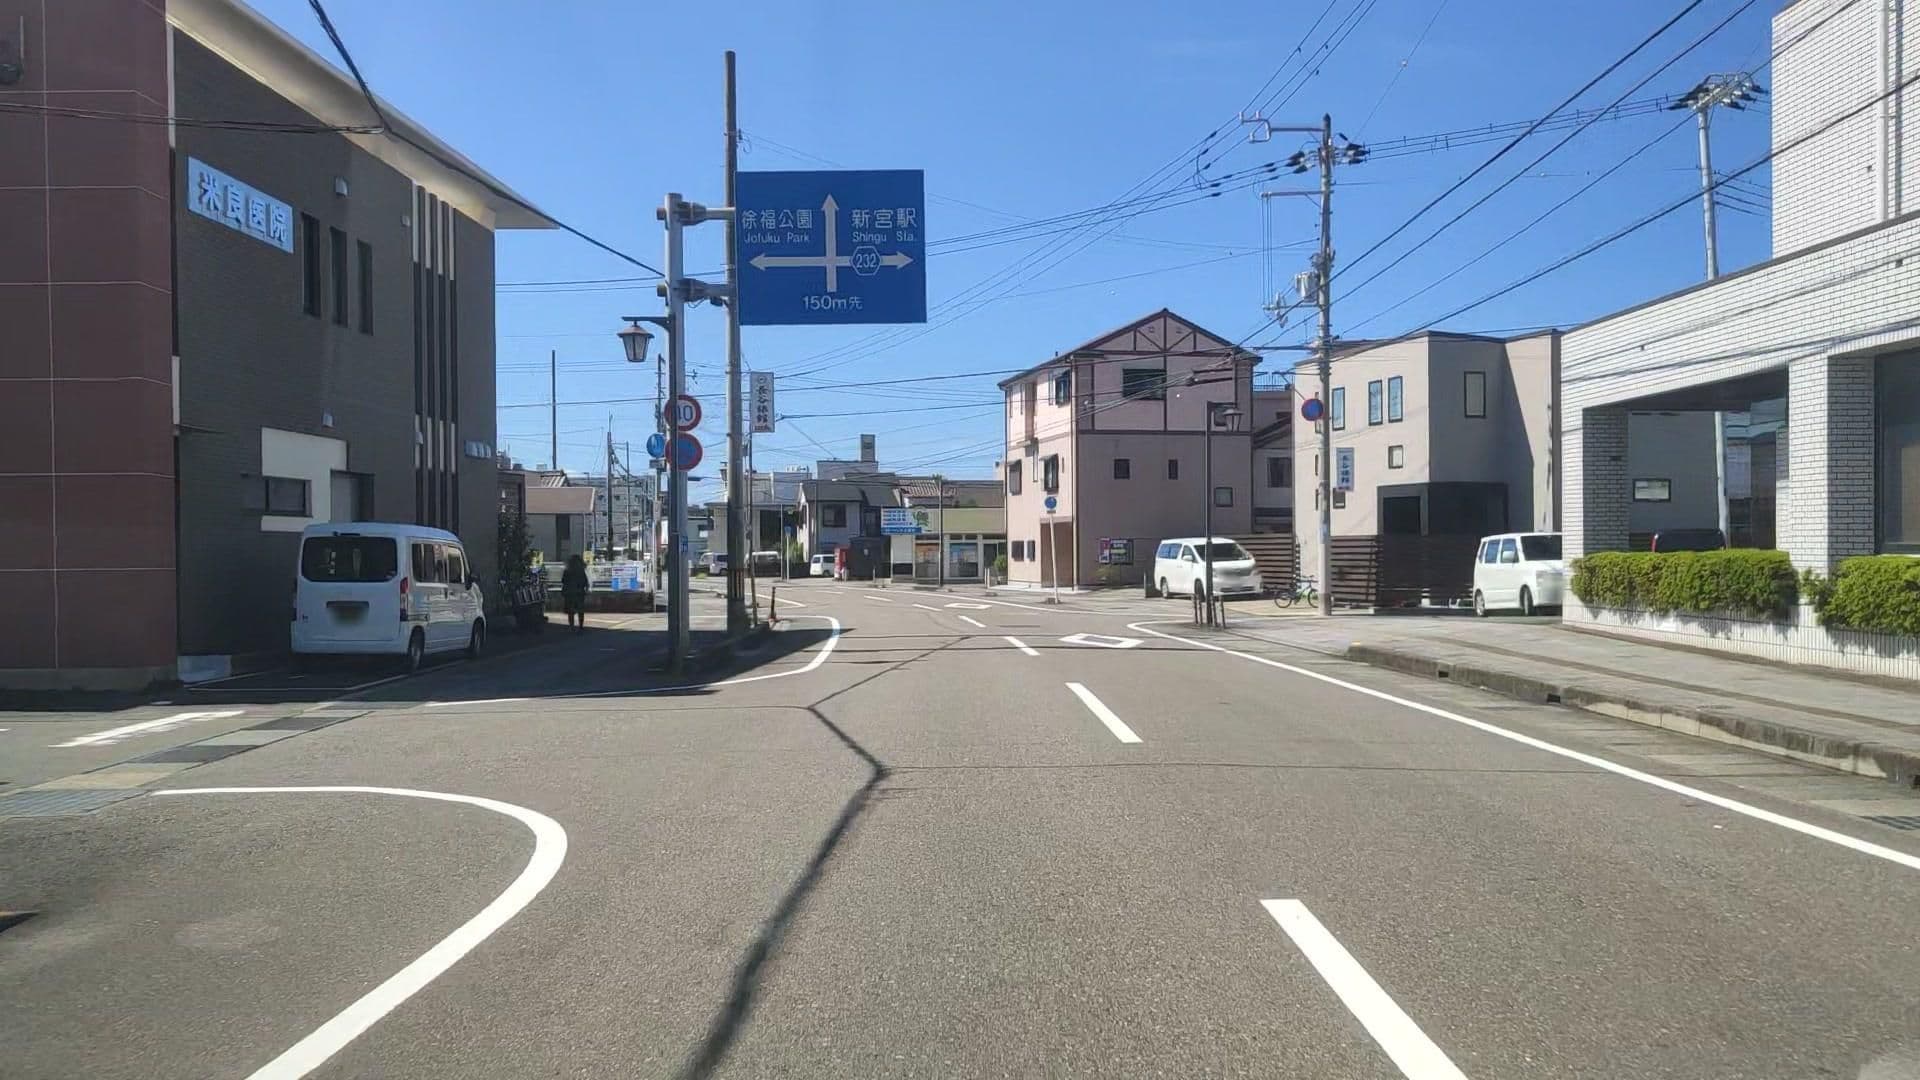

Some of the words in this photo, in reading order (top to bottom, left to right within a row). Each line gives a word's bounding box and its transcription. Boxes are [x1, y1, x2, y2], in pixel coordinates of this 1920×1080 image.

[199, 171, 287, 245] 米良医院
[742, 209, 812, 229] 徐福公園
[851, 208, 918, 229] 新宮駅
[744, 232, 780, 244] Jofuku
[787, 232, 809, 242] Park
[852, 231, 887, 244] Shingu
[896, 231, 916, 242] Sta.
[855, 253, 877, 269] 232
[803, 295, 863, 310] 150m先
